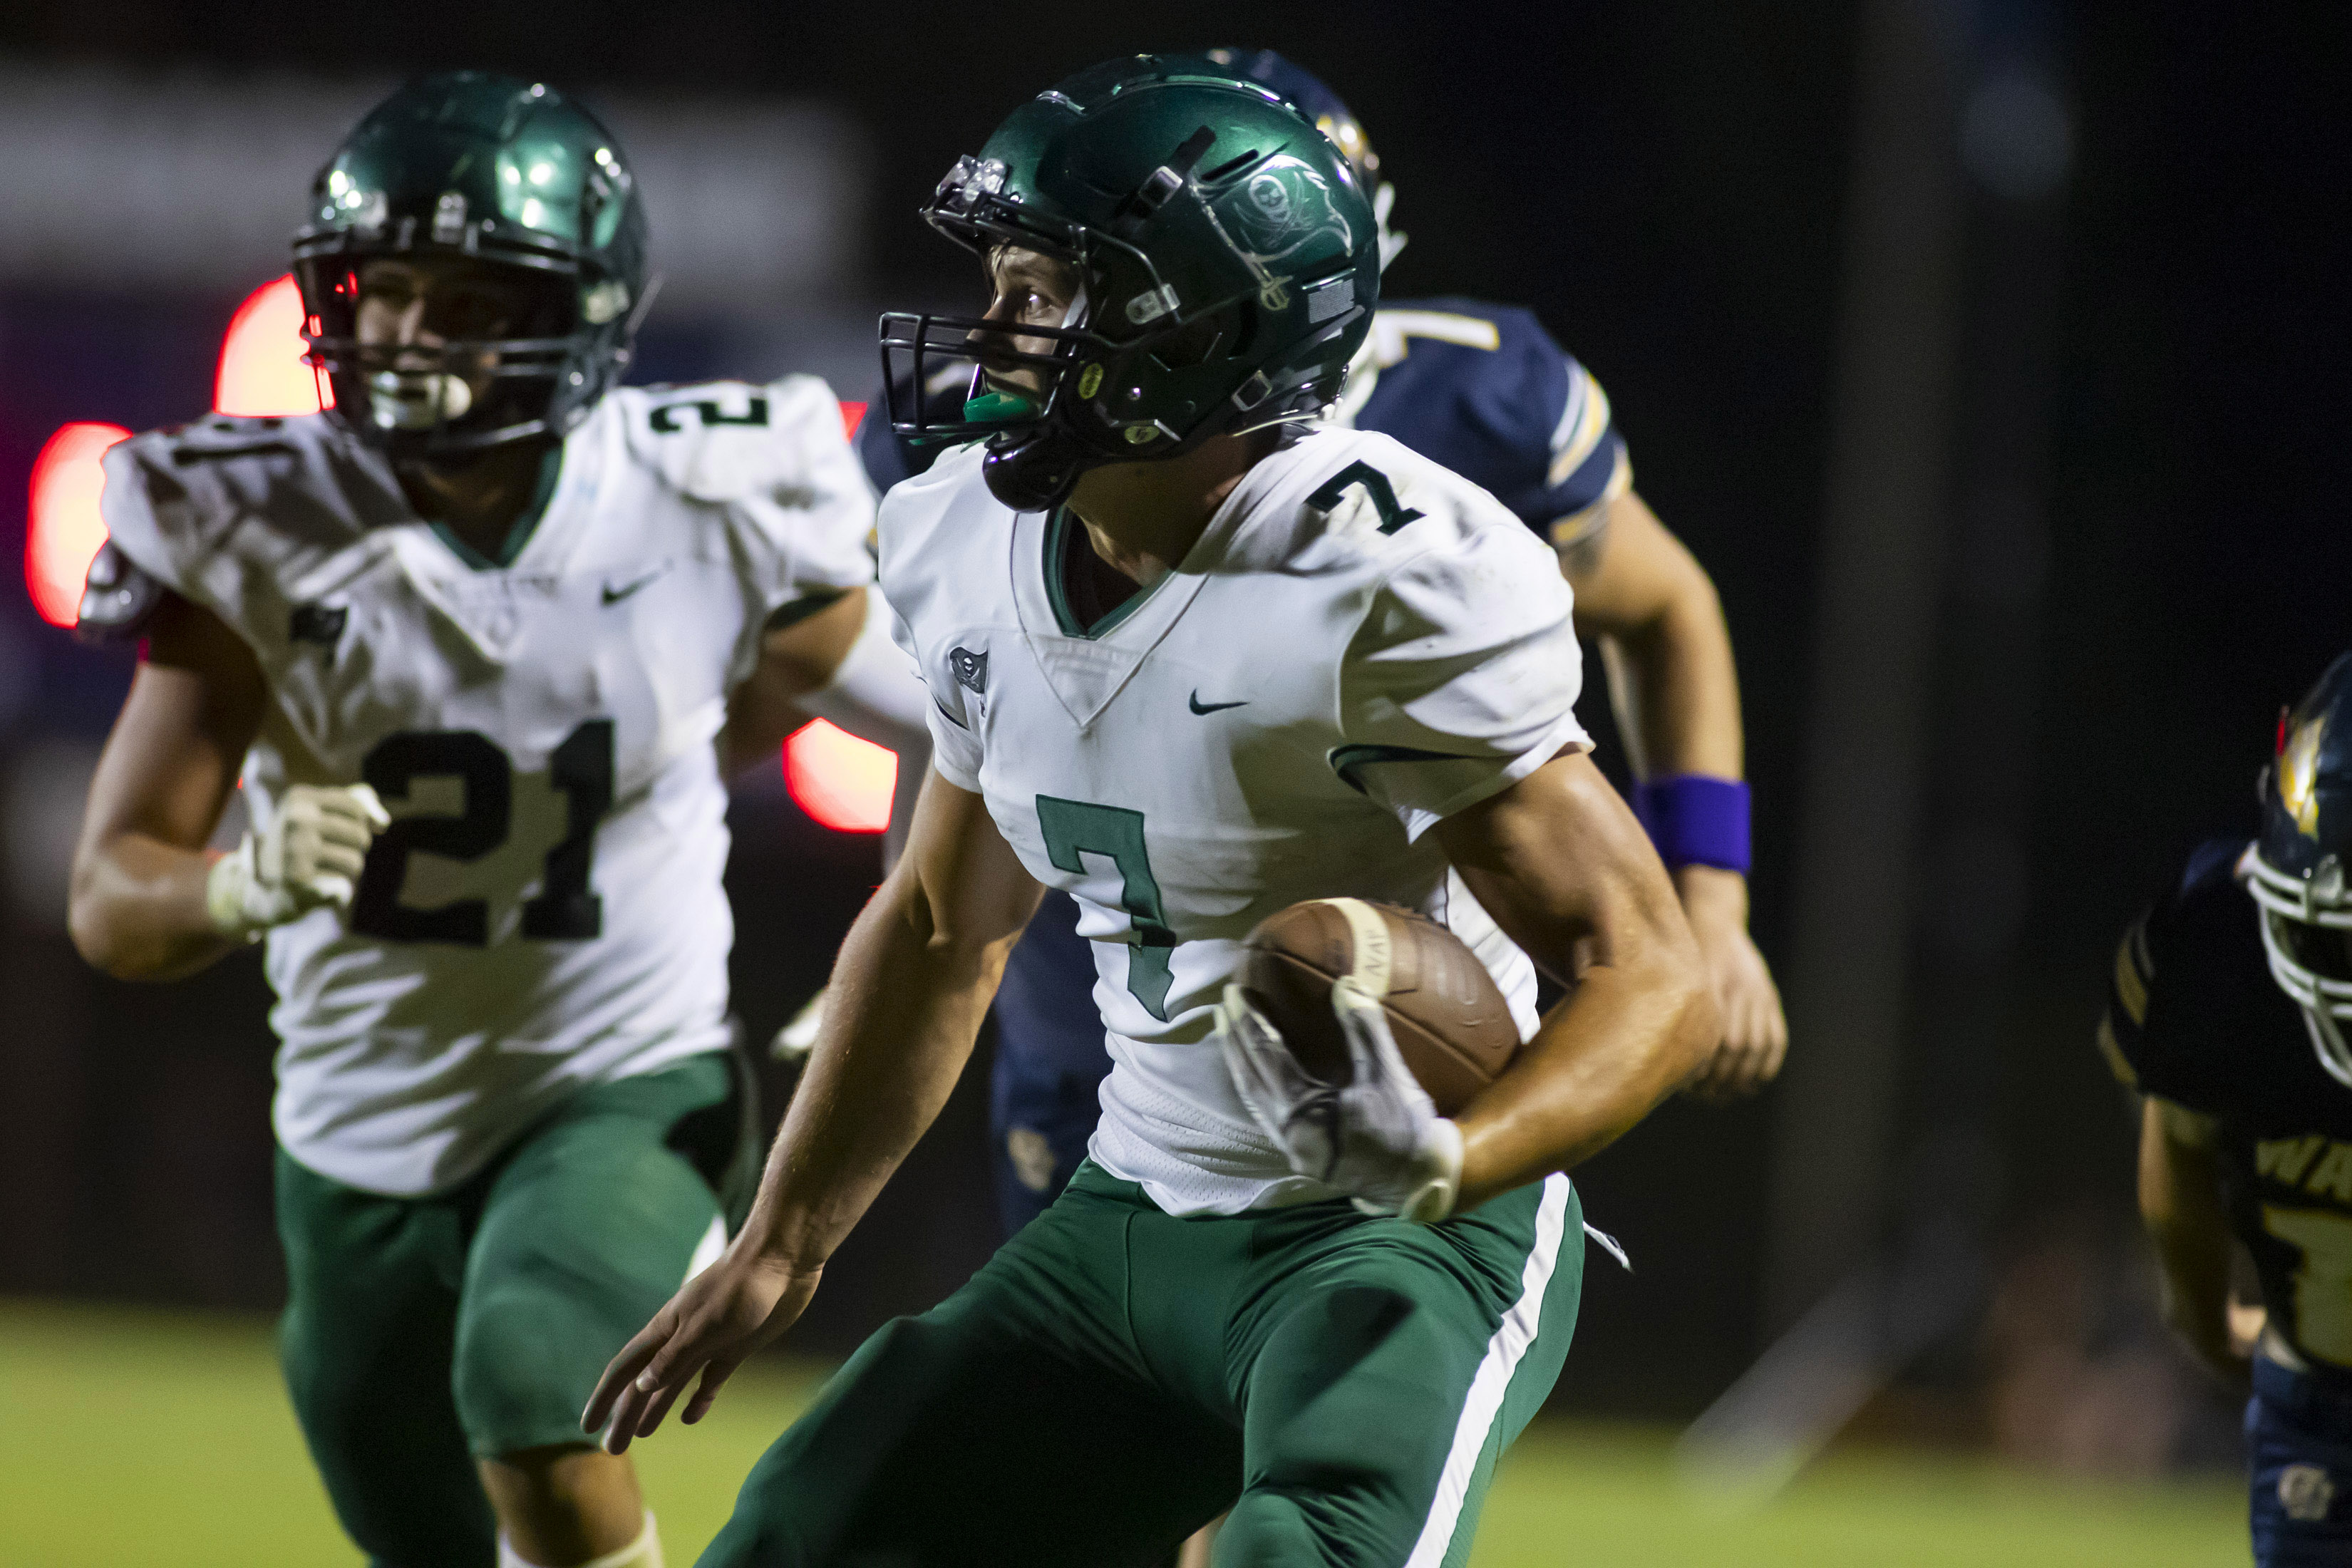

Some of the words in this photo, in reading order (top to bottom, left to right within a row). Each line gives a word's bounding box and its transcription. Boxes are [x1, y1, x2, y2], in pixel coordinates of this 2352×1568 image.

[1303, 458, 1427, 537] 7
[351, 718, 616, 949] 21
[1036, 793, 1177, 1024] 7
